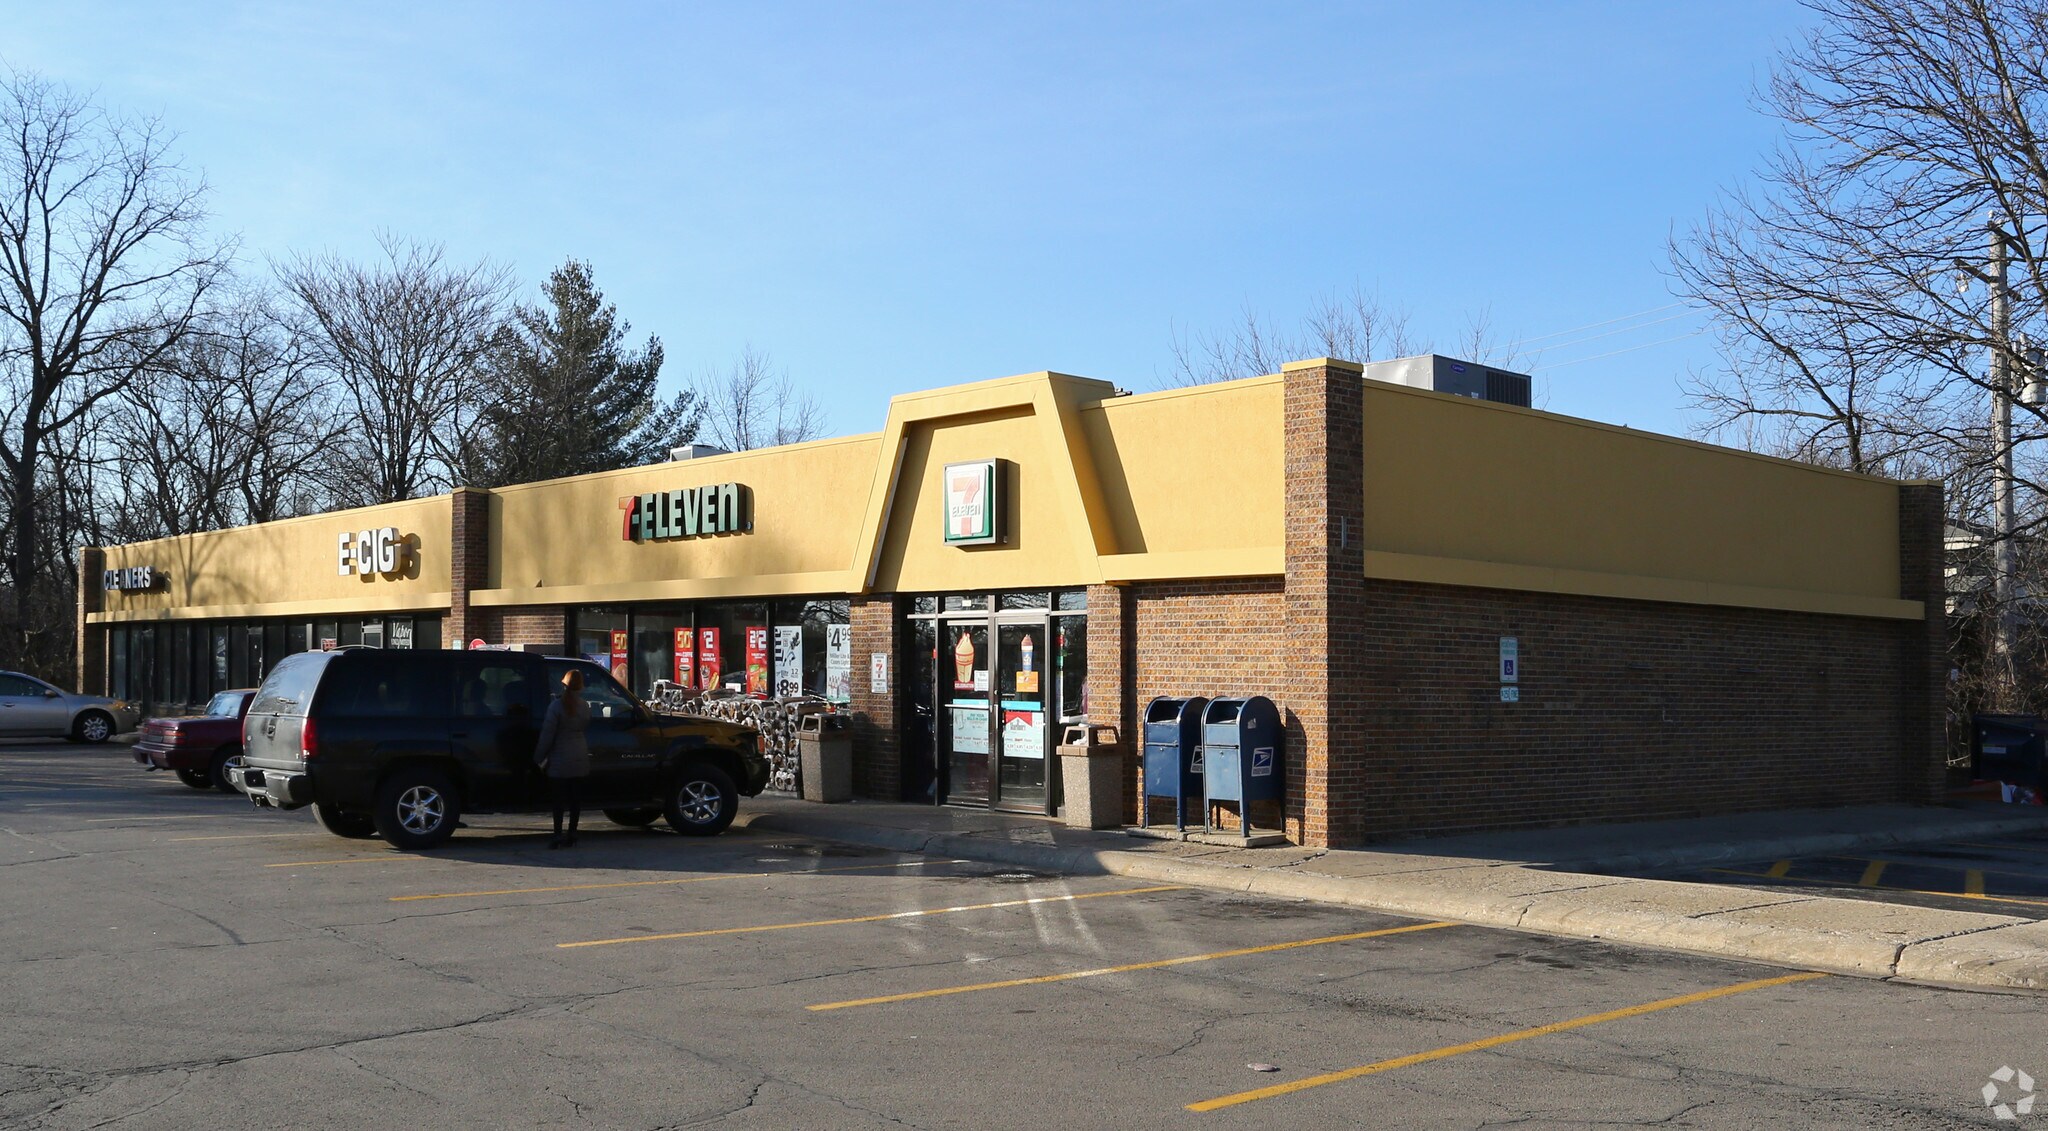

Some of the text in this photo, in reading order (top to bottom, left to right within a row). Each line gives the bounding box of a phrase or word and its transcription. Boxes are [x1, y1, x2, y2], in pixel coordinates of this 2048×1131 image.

[953, 475, 980, 536] 7
[338, 527, 398, 576] E-CIG
[103, 566, 151, 590] CLEANERS
